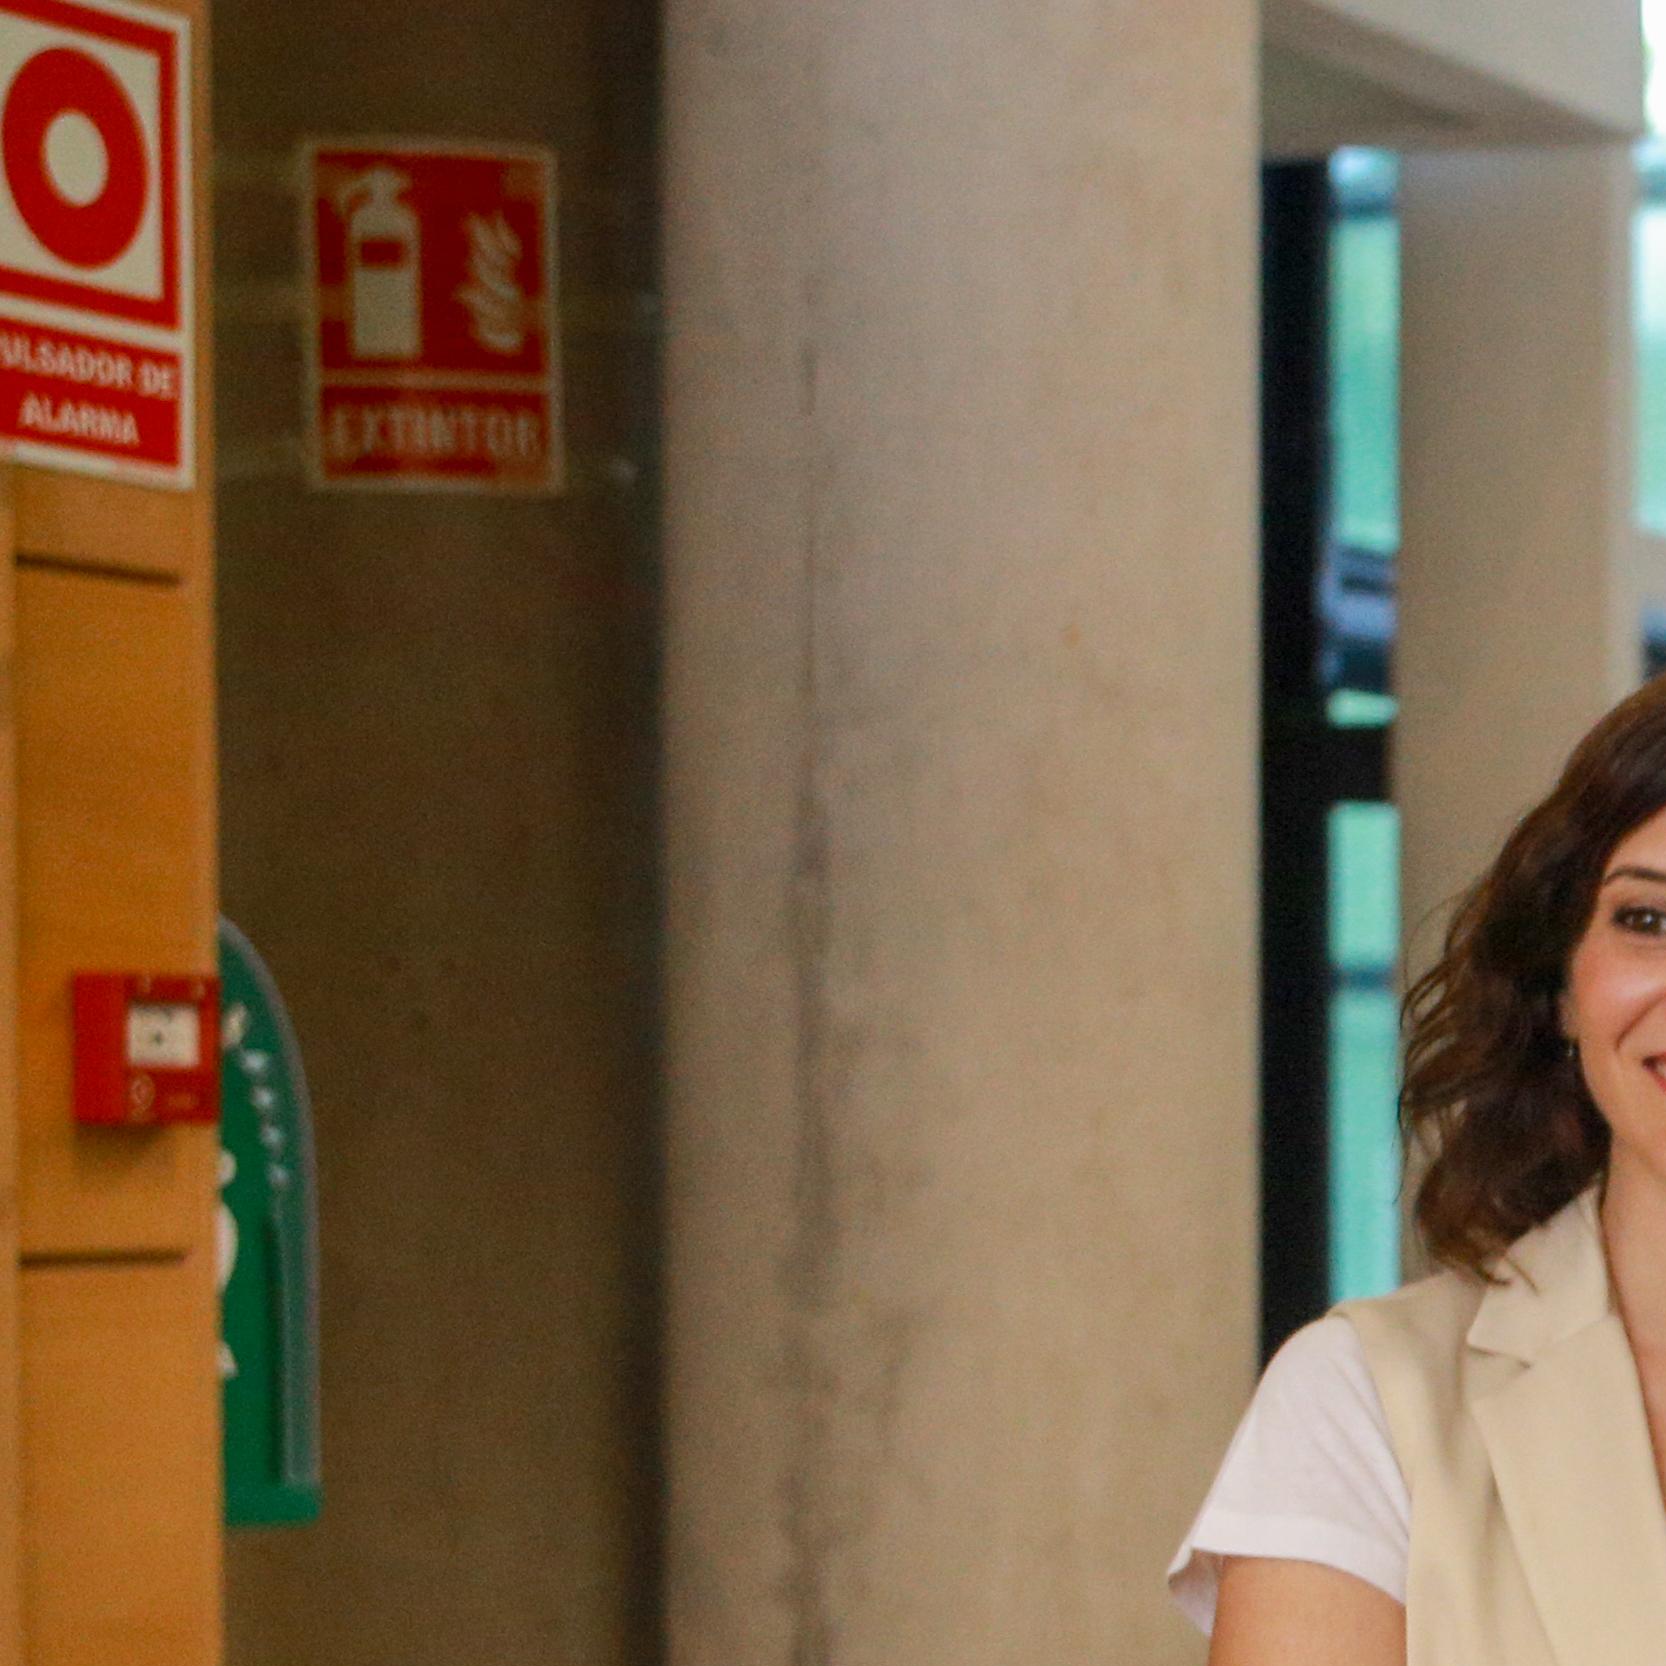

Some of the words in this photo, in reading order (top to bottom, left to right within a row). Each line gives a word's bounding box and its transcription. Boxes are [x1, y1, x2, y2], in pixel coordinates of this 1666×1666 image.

[0, 331, 134, 389] ULSADOR
[138, 361, 177, 400] DE
[18, 392, 140, 445] ALARMA
[329, 404, 543, 458] EXTINTOR
